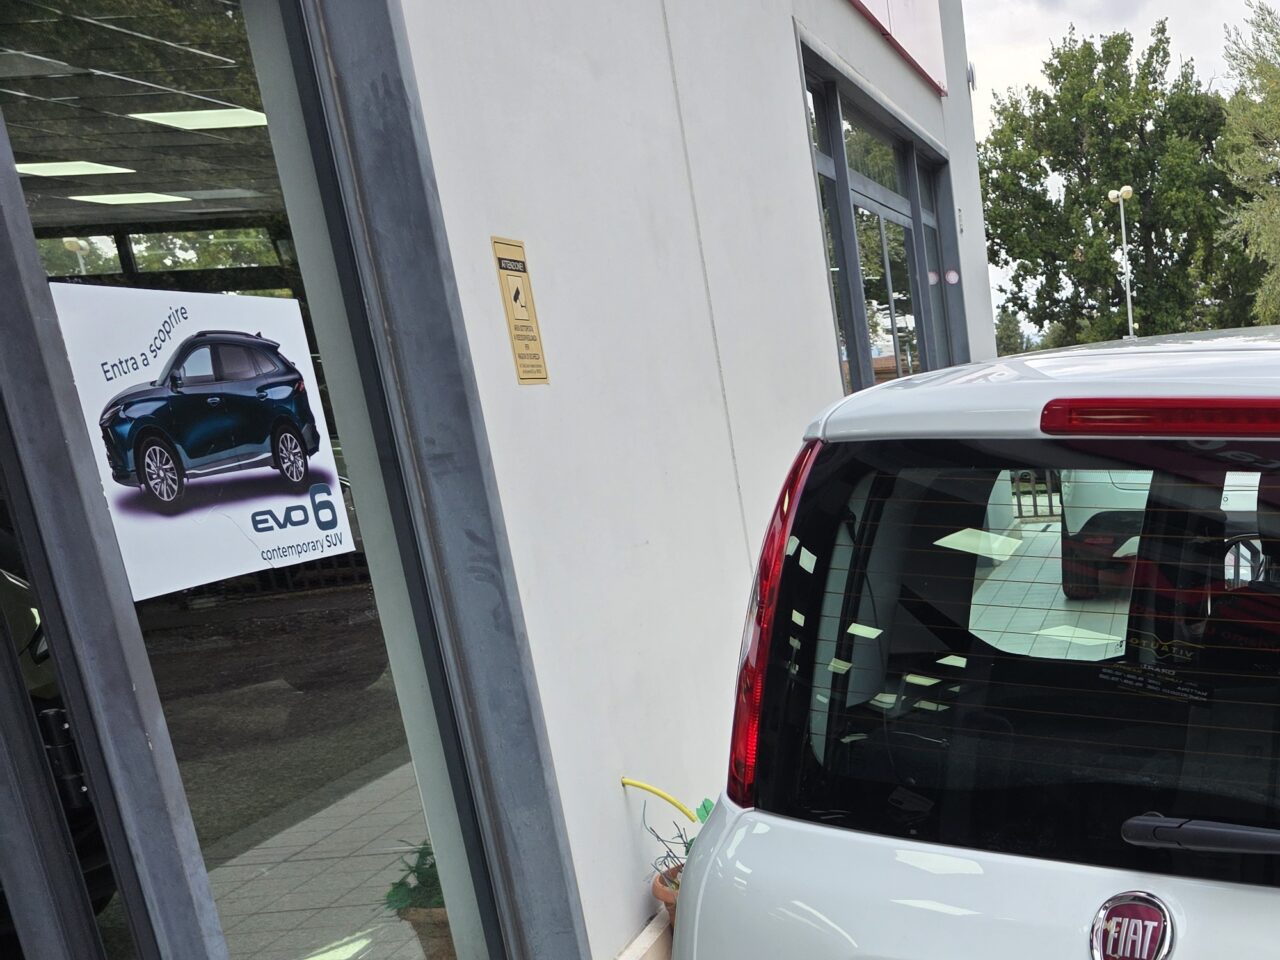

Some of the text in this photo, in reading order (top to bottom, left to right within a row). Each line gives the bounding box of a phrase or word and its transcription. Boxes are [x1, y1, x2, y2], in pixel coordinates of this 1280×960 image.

[101, 305, 189, 382] Entra a scoprire
[261, 532, 343, 561] contemporary SUV
[1106, 916, 1159, 960] FIAT
